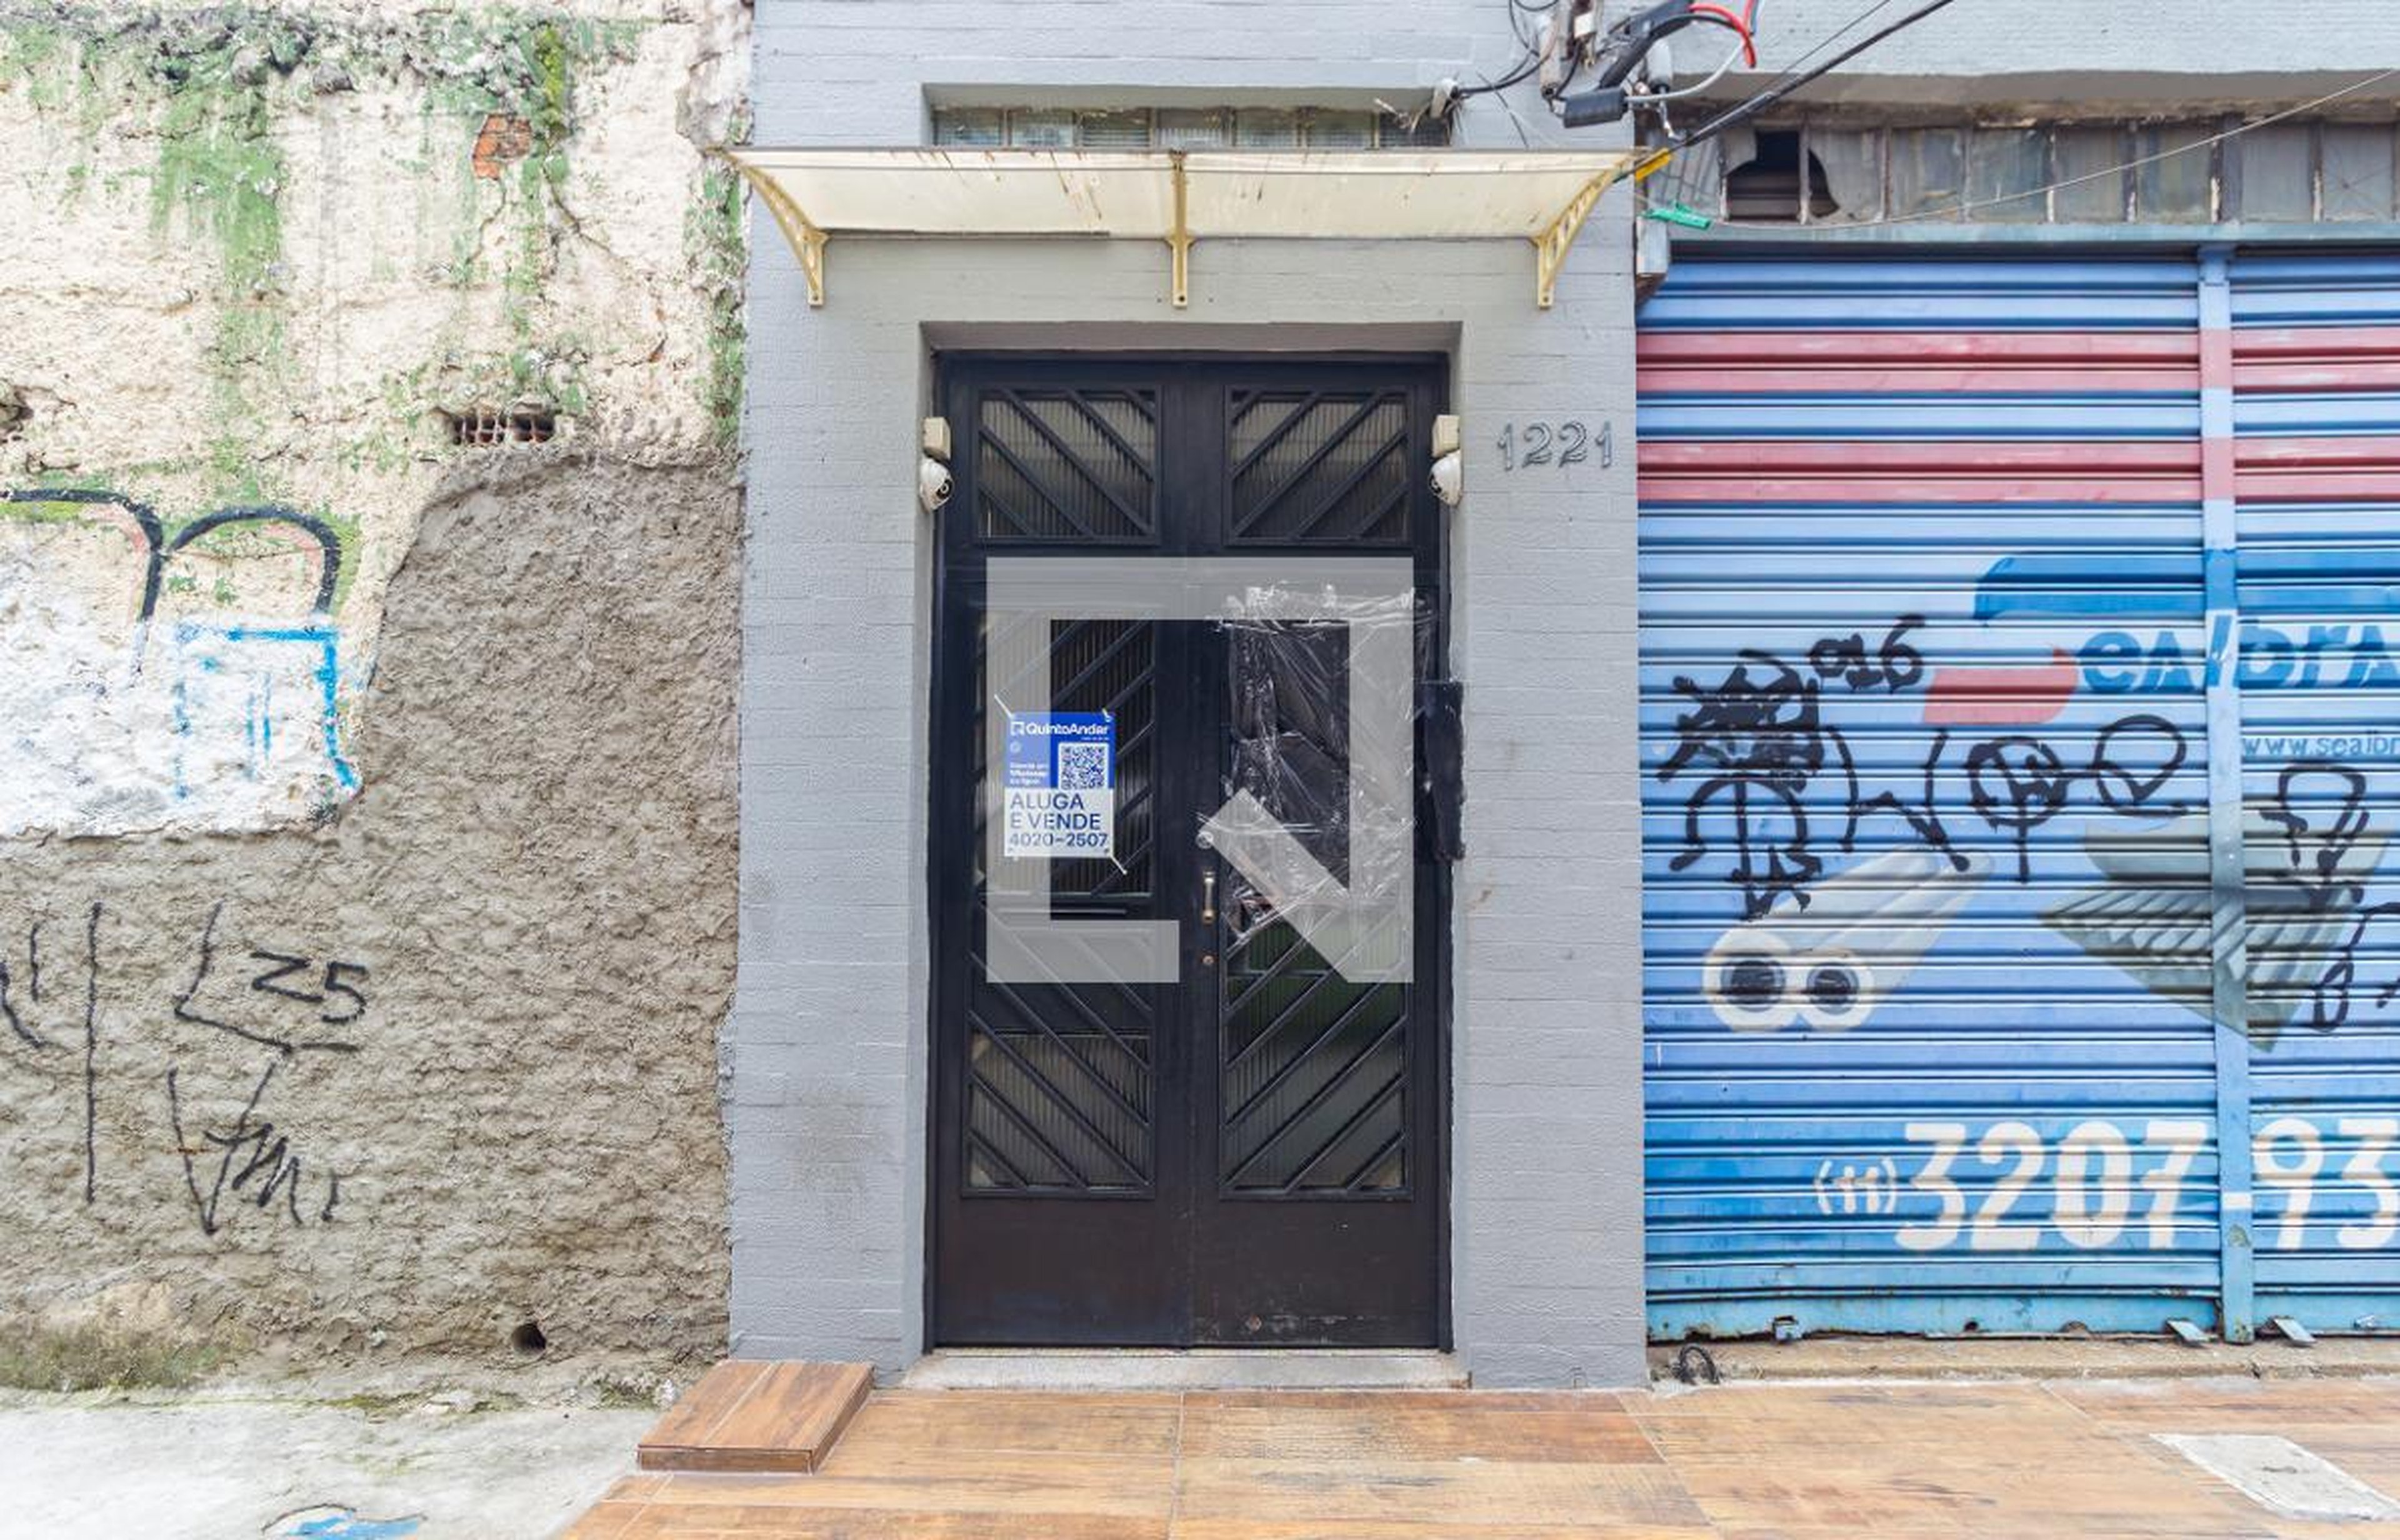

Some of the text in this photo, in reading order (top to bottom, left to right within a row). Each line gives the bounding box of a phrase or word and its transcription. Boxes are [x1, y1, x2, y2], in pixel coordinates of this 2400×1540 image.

[1498, 421, 1613, 471] 1221
[1026, 722, 1109, 736] QuintoAndar
[1010, 793, 1084, 810] ALUGA
[1010, 813, 1101, 830] E VENDE
[1009, 833, 1108, 848] 4020-2507
[1814, 1157, 1898, 1216] (11)
